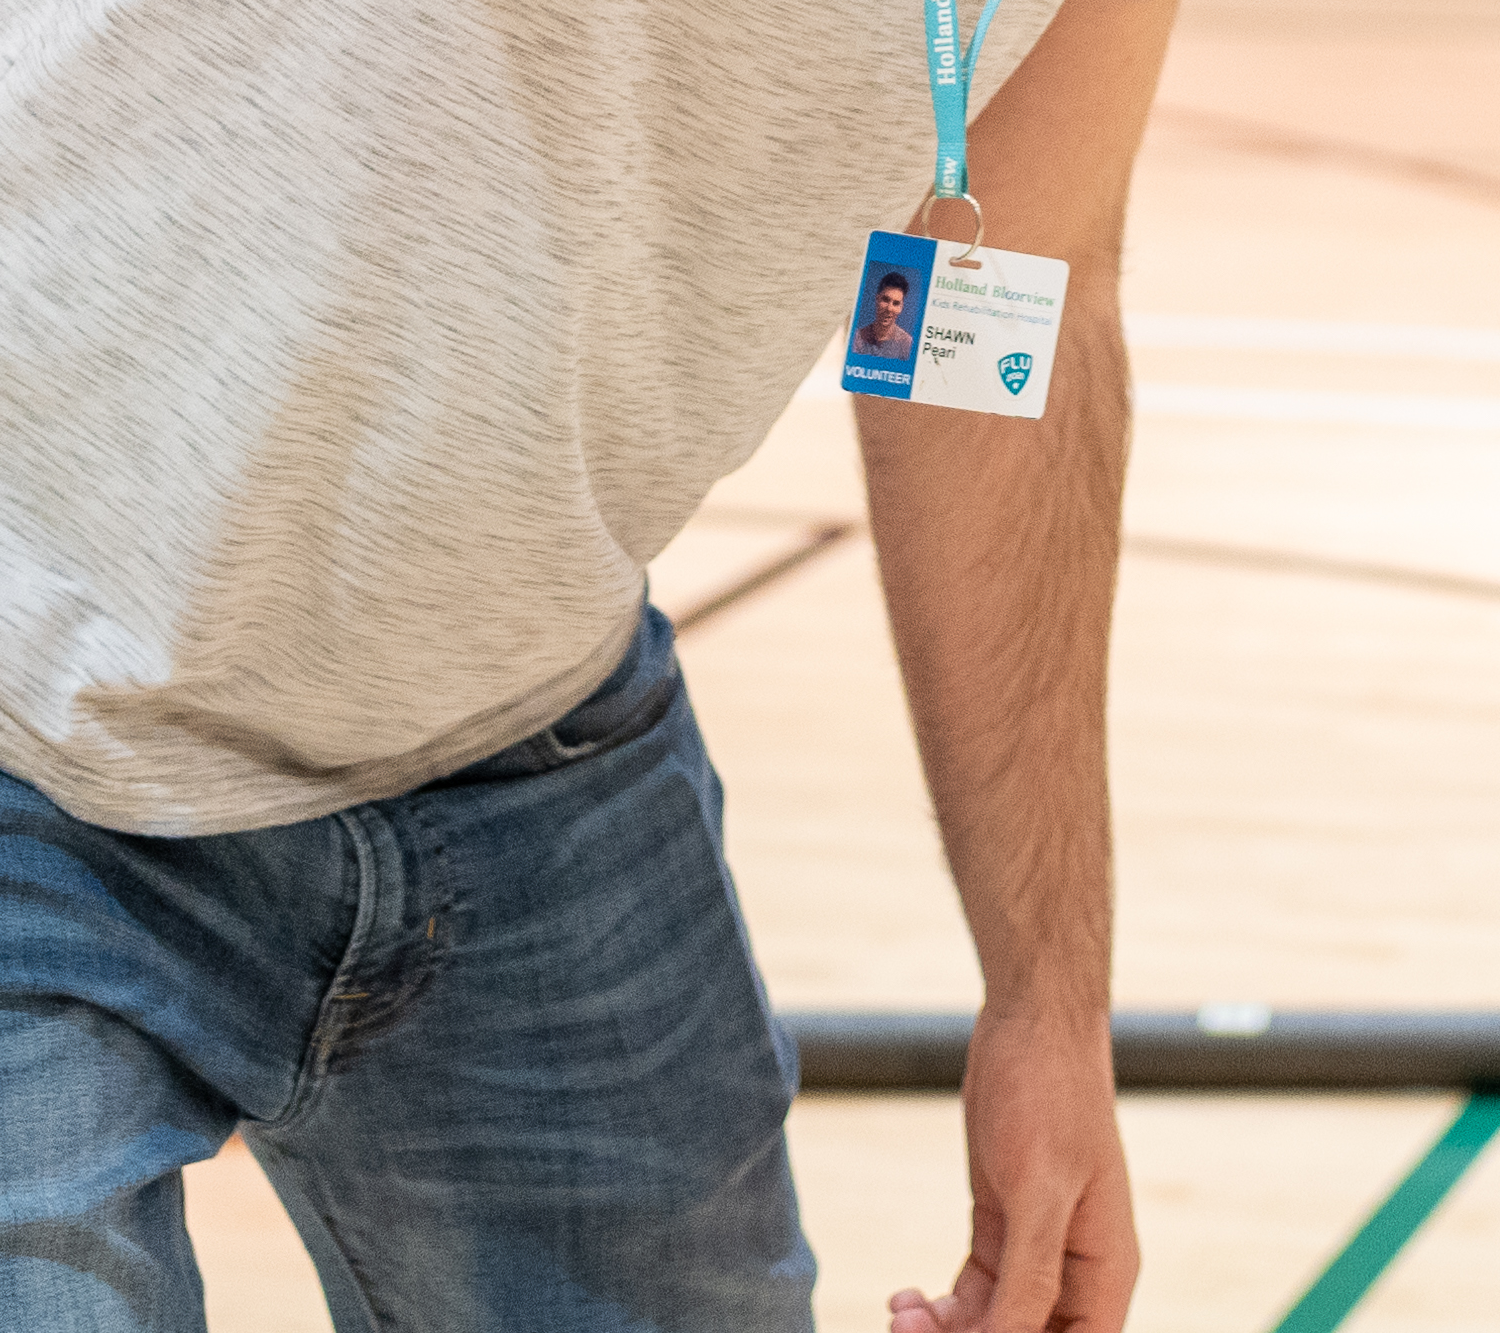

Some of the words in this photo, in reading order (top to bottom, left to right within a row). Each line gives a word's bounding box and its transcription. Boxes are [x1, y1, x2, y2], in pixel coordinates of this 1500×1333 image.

[935, 276, 988, 296] Holland
[992, 285, 1055, 307] Bloorview
[925, 325, 976, 346] SHAWN
[845, 364, 911, 386] VOLUNTEER
[1000, 355, 1031, 374] FLU
